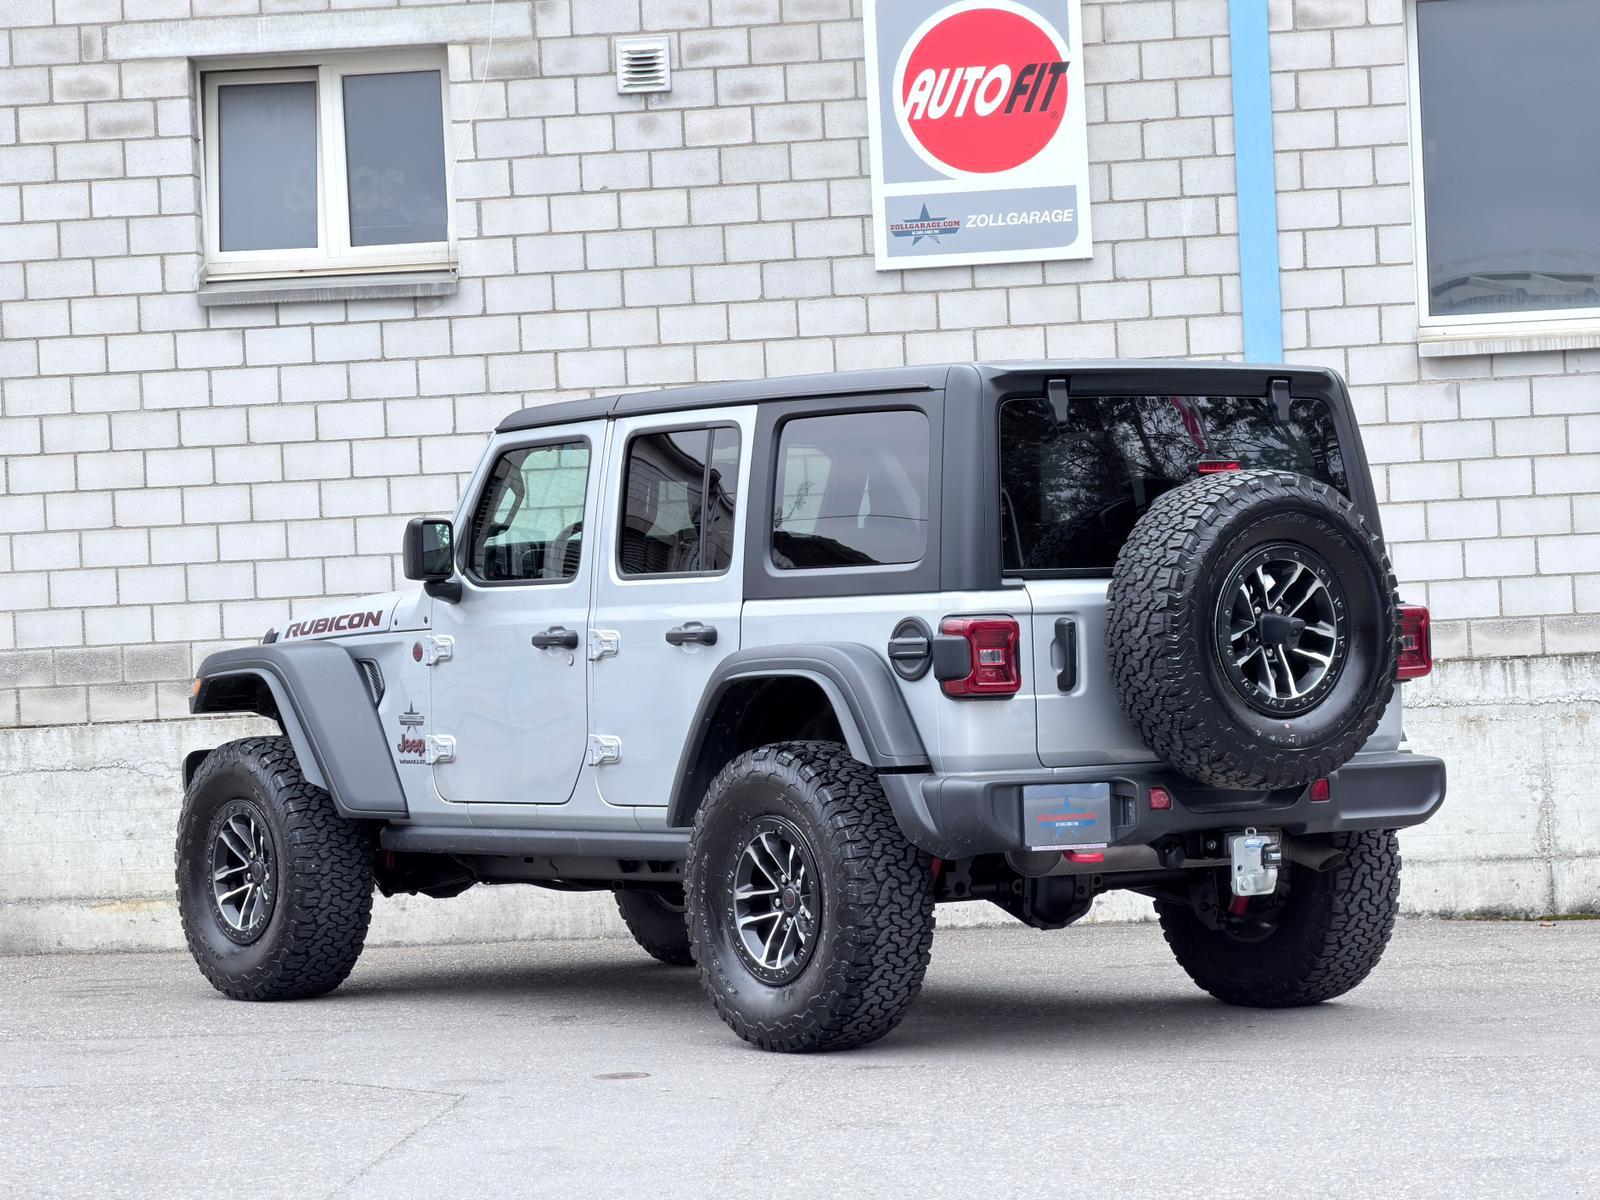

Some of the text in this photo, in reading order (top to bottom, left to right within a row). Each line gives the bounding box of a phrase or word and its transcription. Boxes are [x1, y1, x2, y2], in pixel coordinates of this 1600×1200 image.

[904, 60, 1070, 121] AUTOFIT
[889, 220, 961, 231] ZOLLGARAGE.COM
[966, 209, 1074, 229] ZOLLGARAGE
[285, 610, 383, 639] RUBICON
[397, 734, 426, 757] Jeep
